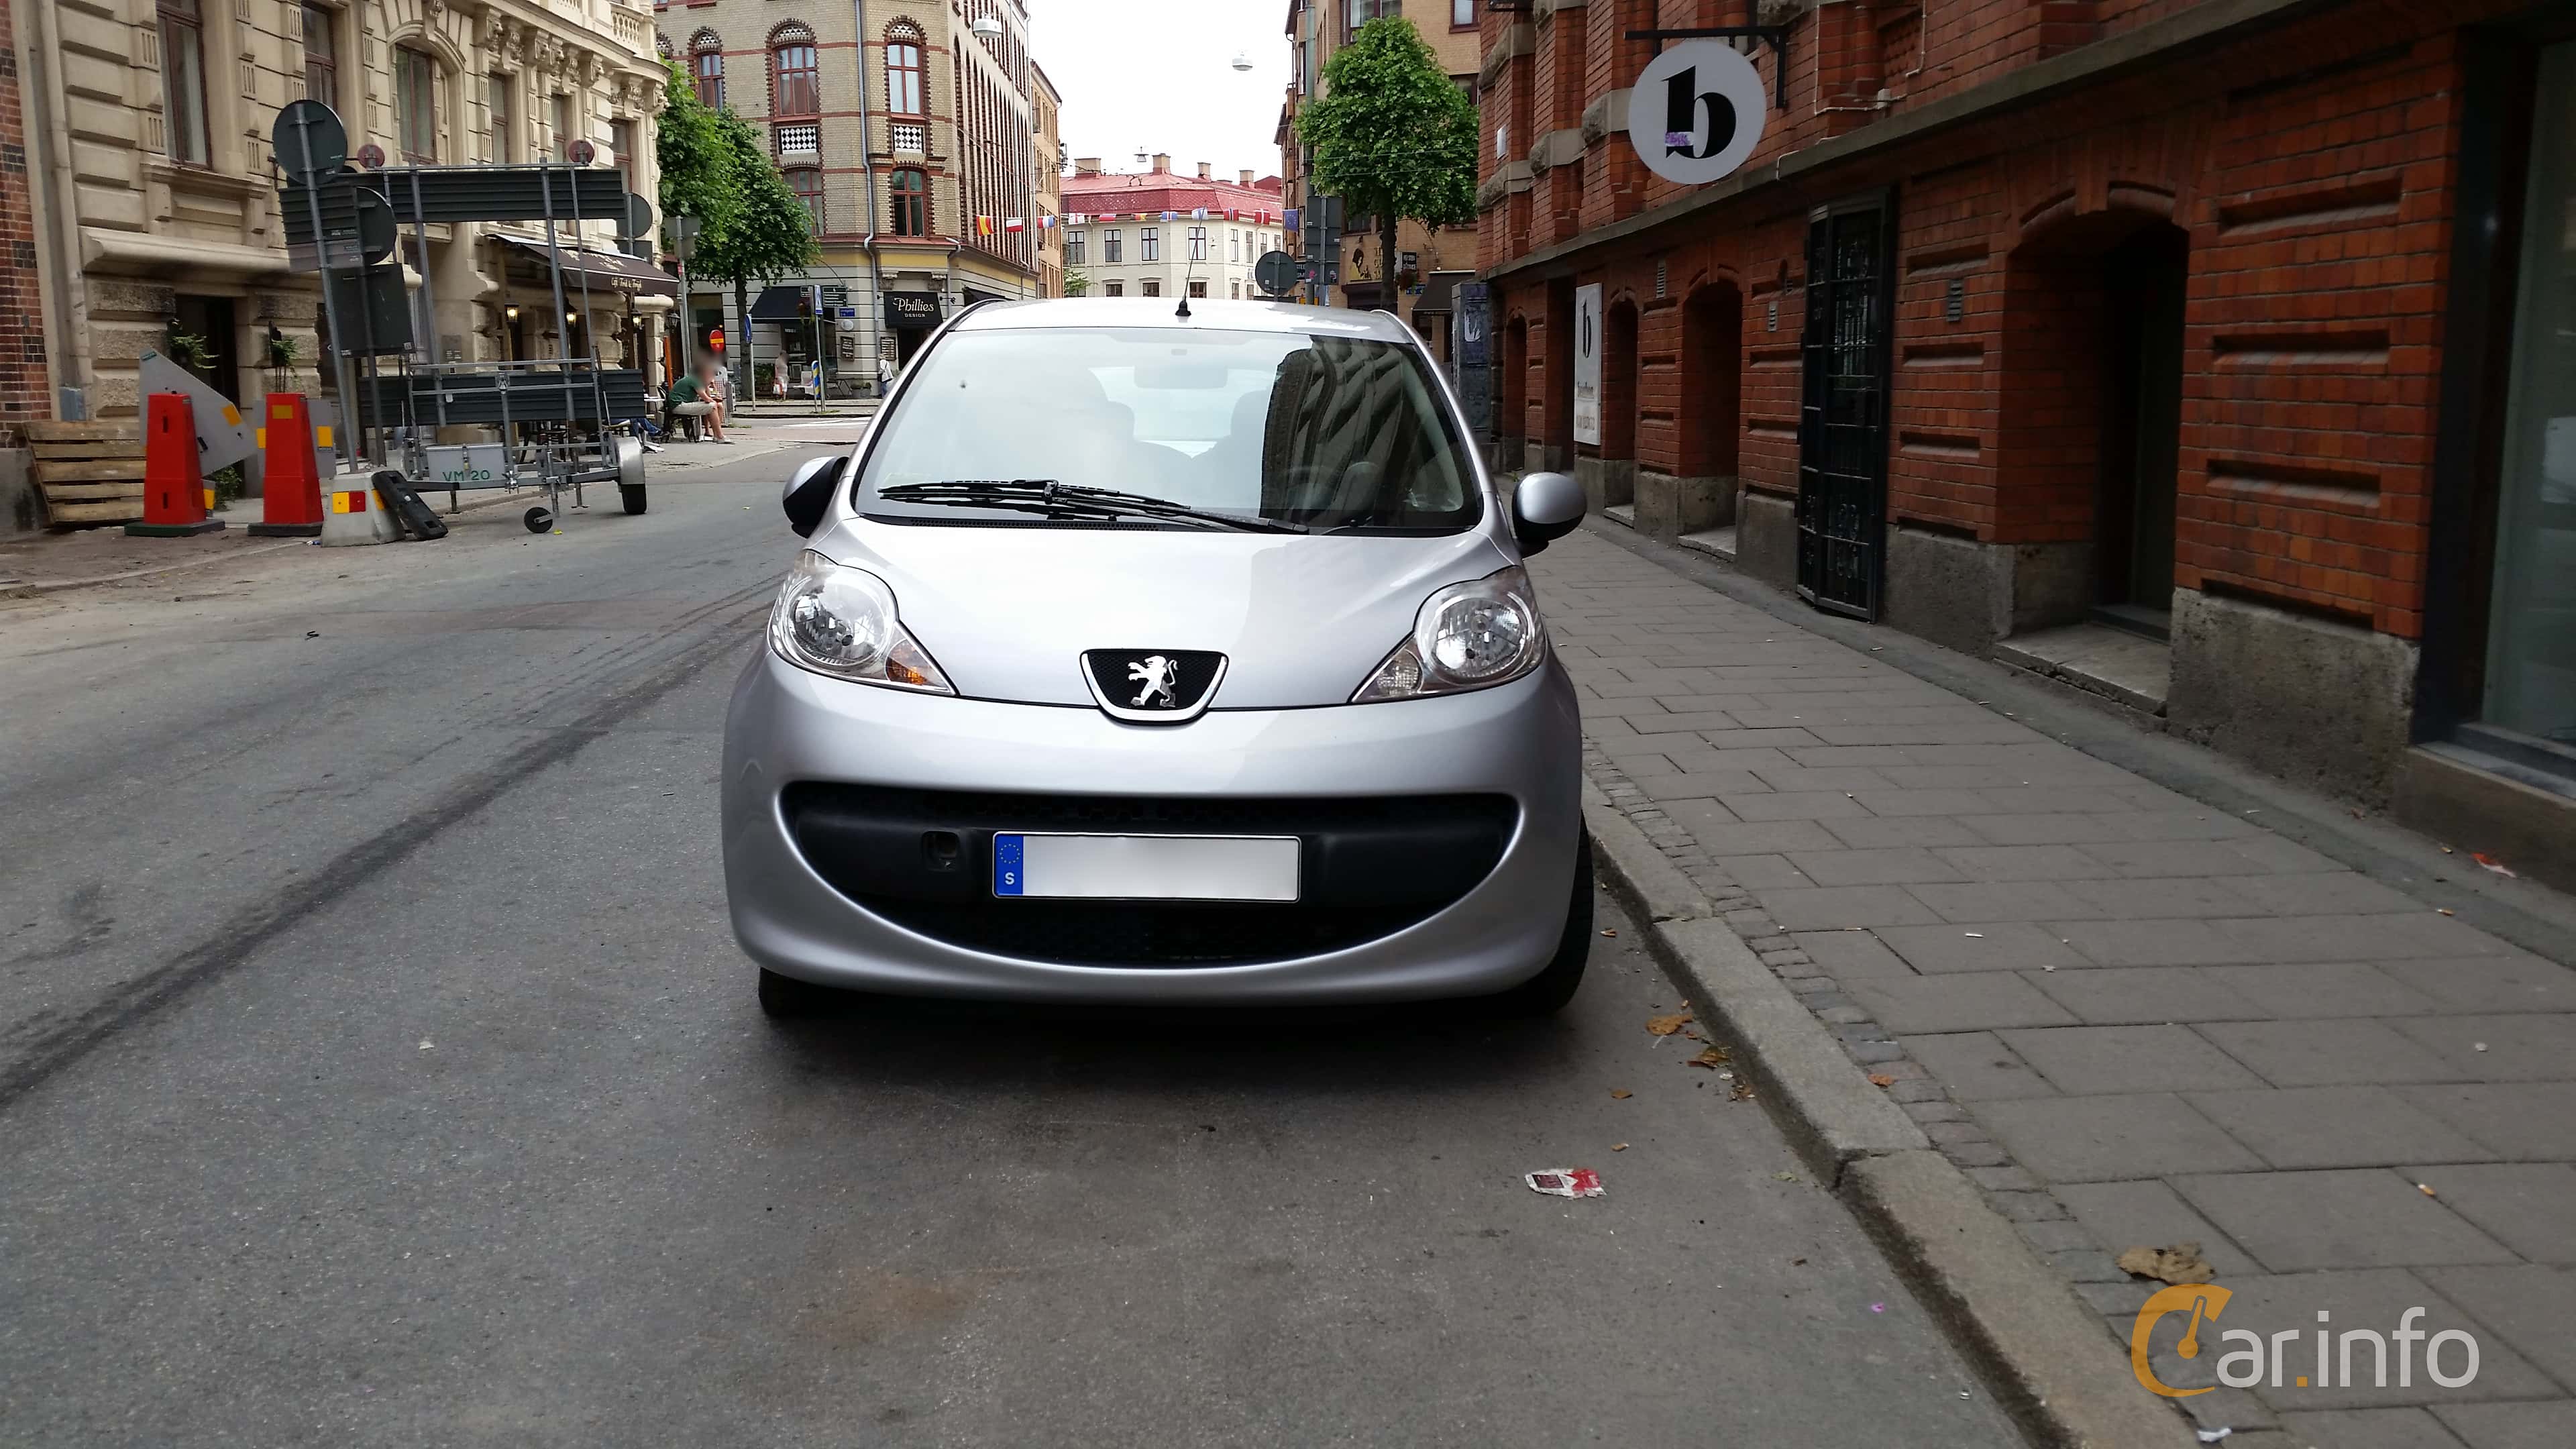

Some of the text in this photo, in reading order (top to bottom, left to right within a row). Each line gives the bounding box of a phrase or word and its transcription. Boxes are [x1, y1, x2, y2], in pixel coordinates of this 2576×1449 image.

[1661, 64, 1737, 160] b
[892, 297, 934, 312] Phillies
[442, 470, 490, 482] VM 20
[1004, 872, 1015, 885] S
